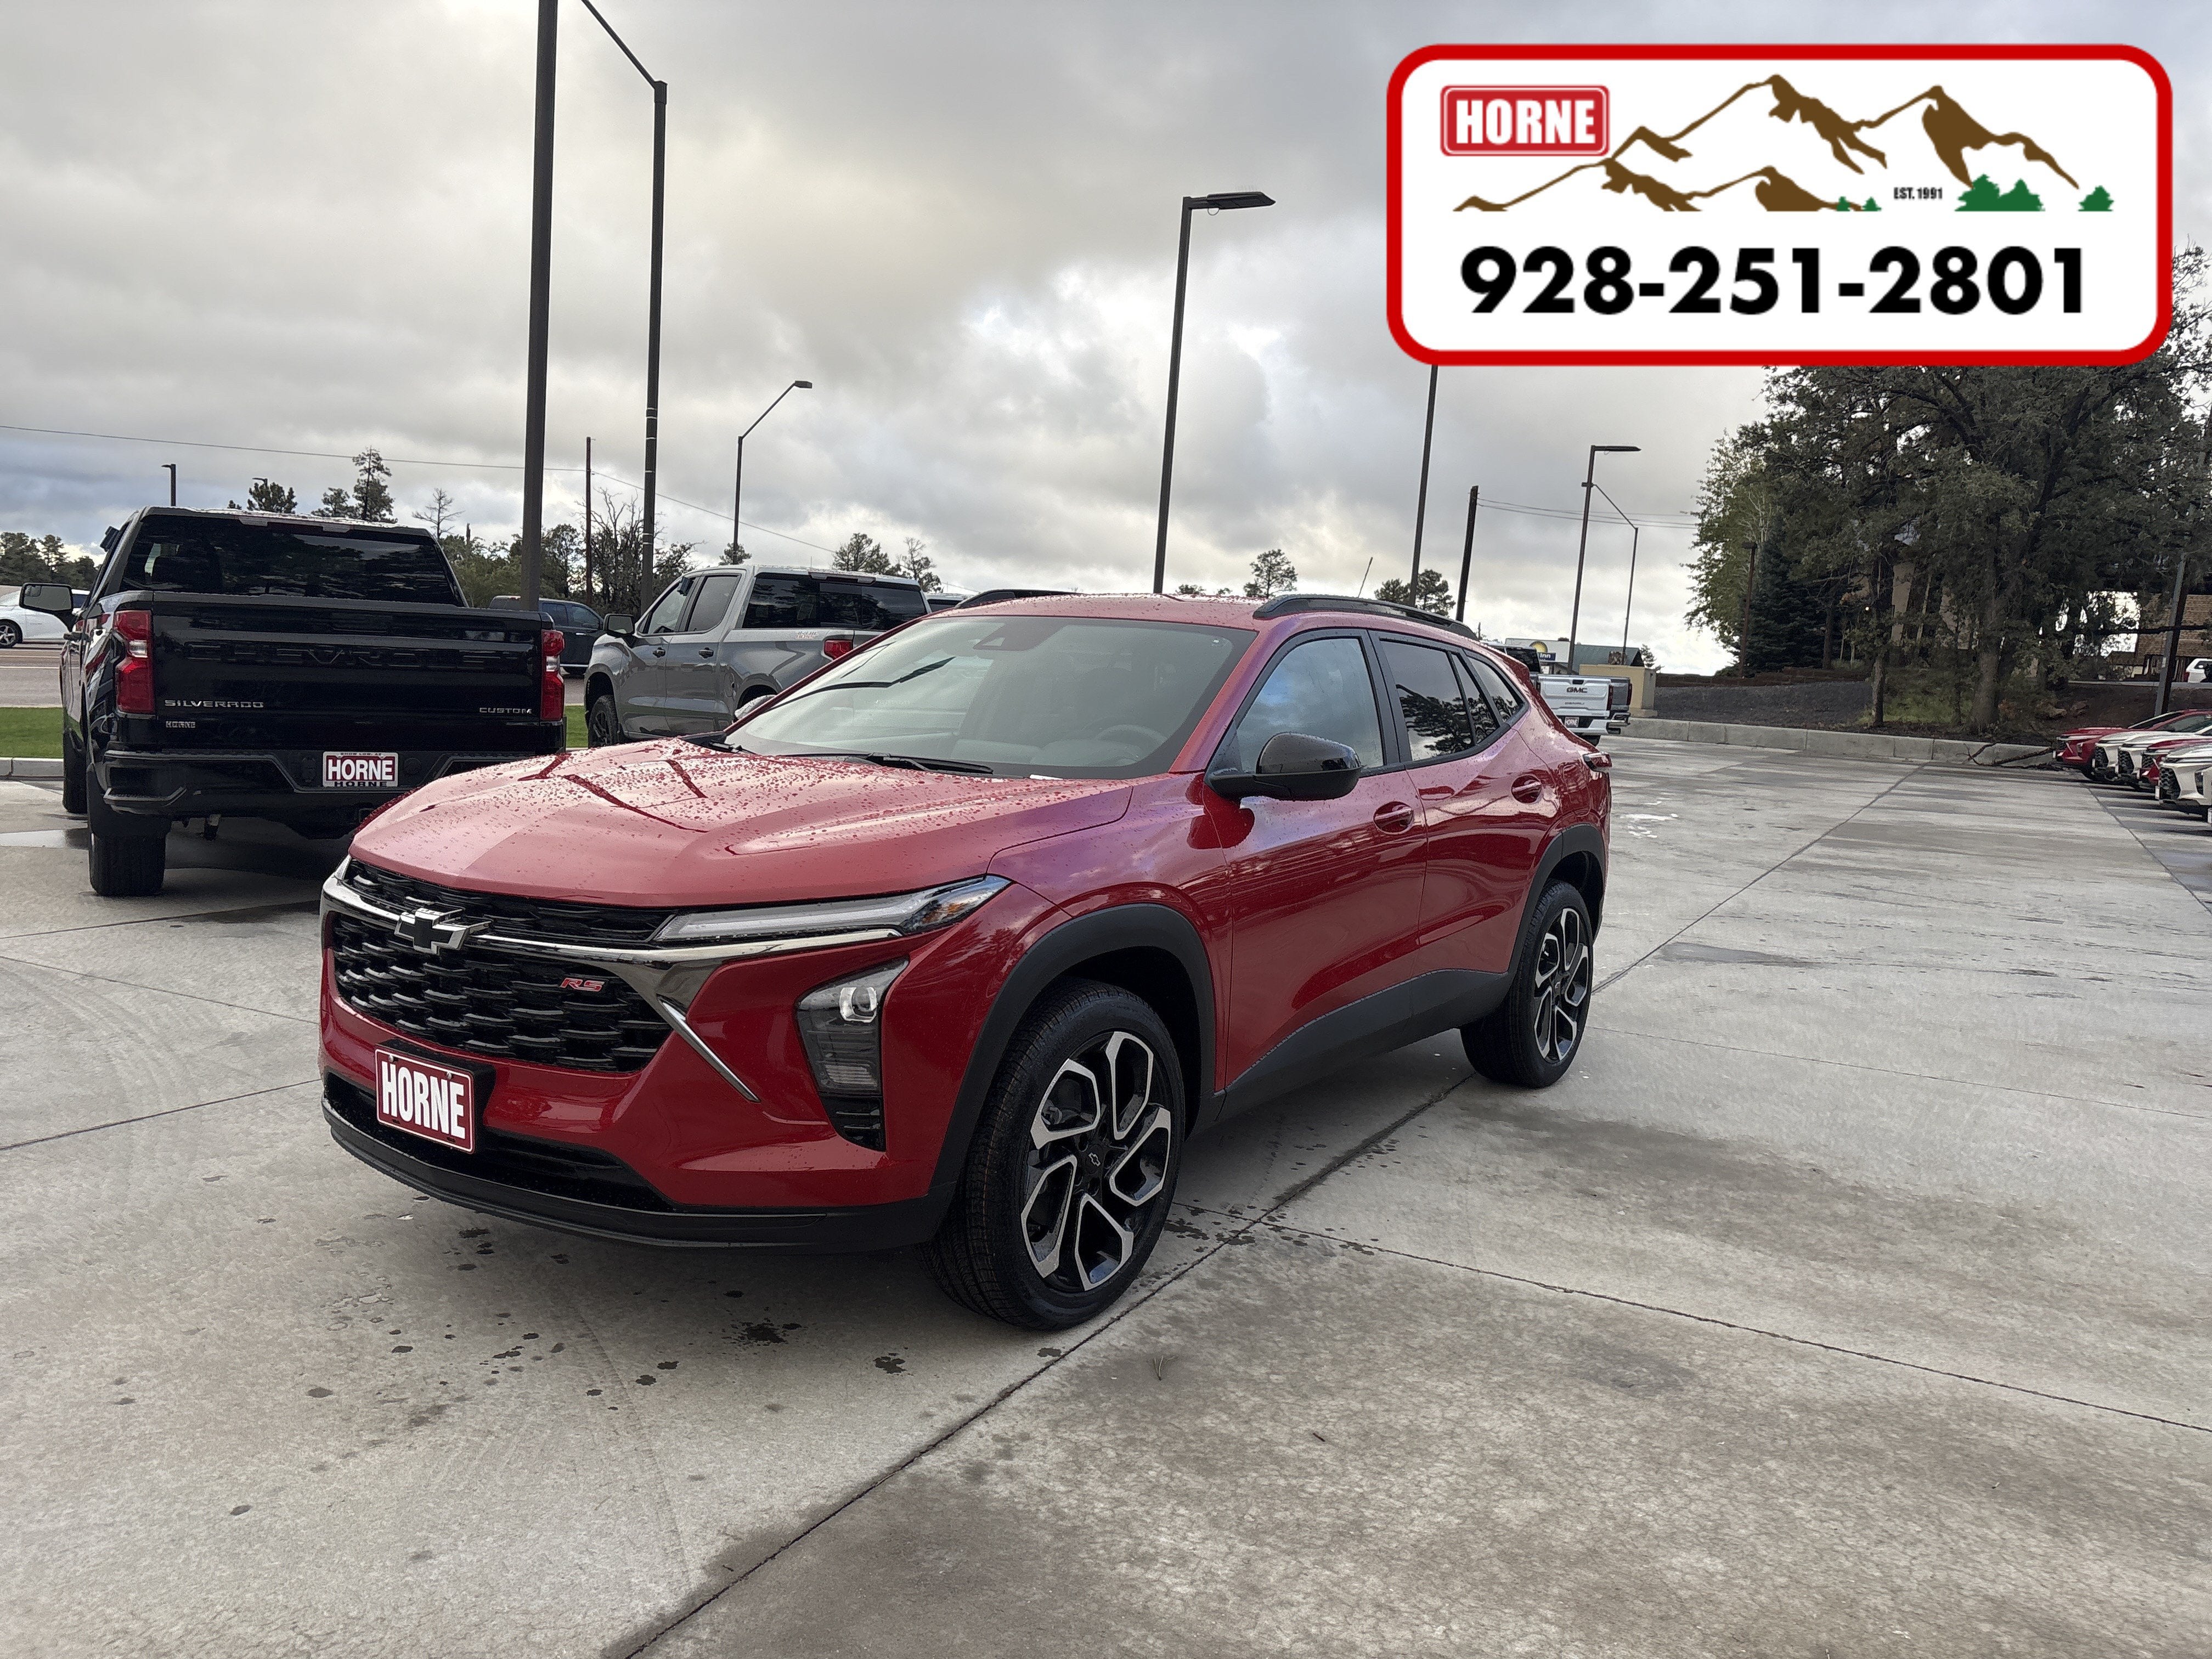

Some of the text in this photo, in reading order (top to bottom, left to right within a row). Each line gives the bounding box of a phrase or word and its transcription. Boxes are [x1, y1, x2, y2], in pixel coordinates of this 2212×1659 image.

[165, 699, 264, 708] SILVERADO
[328, 759, 393, 780] HORNE
[559, 977, 605, 992] RS
[381, 1060, 466, 1139] HORNE
